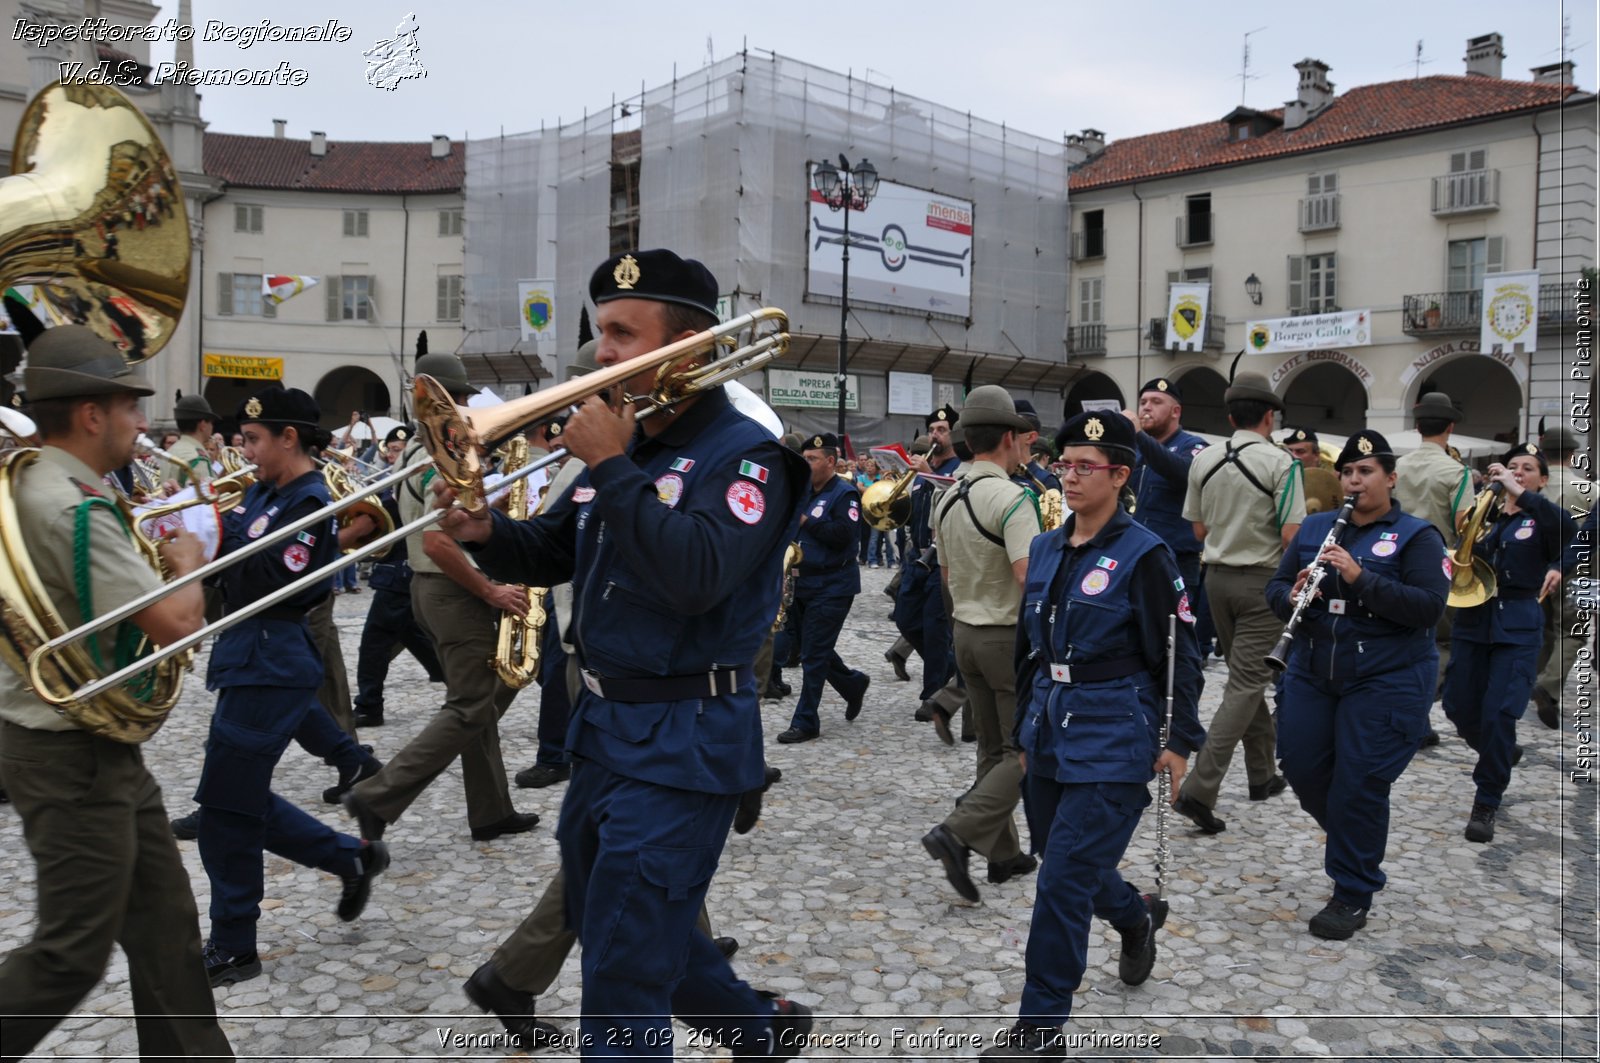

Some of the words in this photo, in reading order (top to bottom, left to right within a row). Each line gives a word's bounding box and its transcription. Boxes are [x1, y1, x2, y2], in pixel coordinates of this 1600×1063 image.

[1315, 316, 1343, 327] Borghi
[1274, 330, 1312, 342] Borgo
[1315, 326, 1351, 339] Gallo
[220, 356, 252, 365] BANCO
[258, 358, 268, 367] DI
[1412, 343, 1455, 371] NUOVA
[207, 364, 280, 377] BENEFICENZA
[1306, 350, 1371, 381] RISTORANTE
[799, 378, 831, 389] IMPRESA
[771, 388, 807, 398] EDILIZIA
[809, 390, 855, 400] GENERLE
